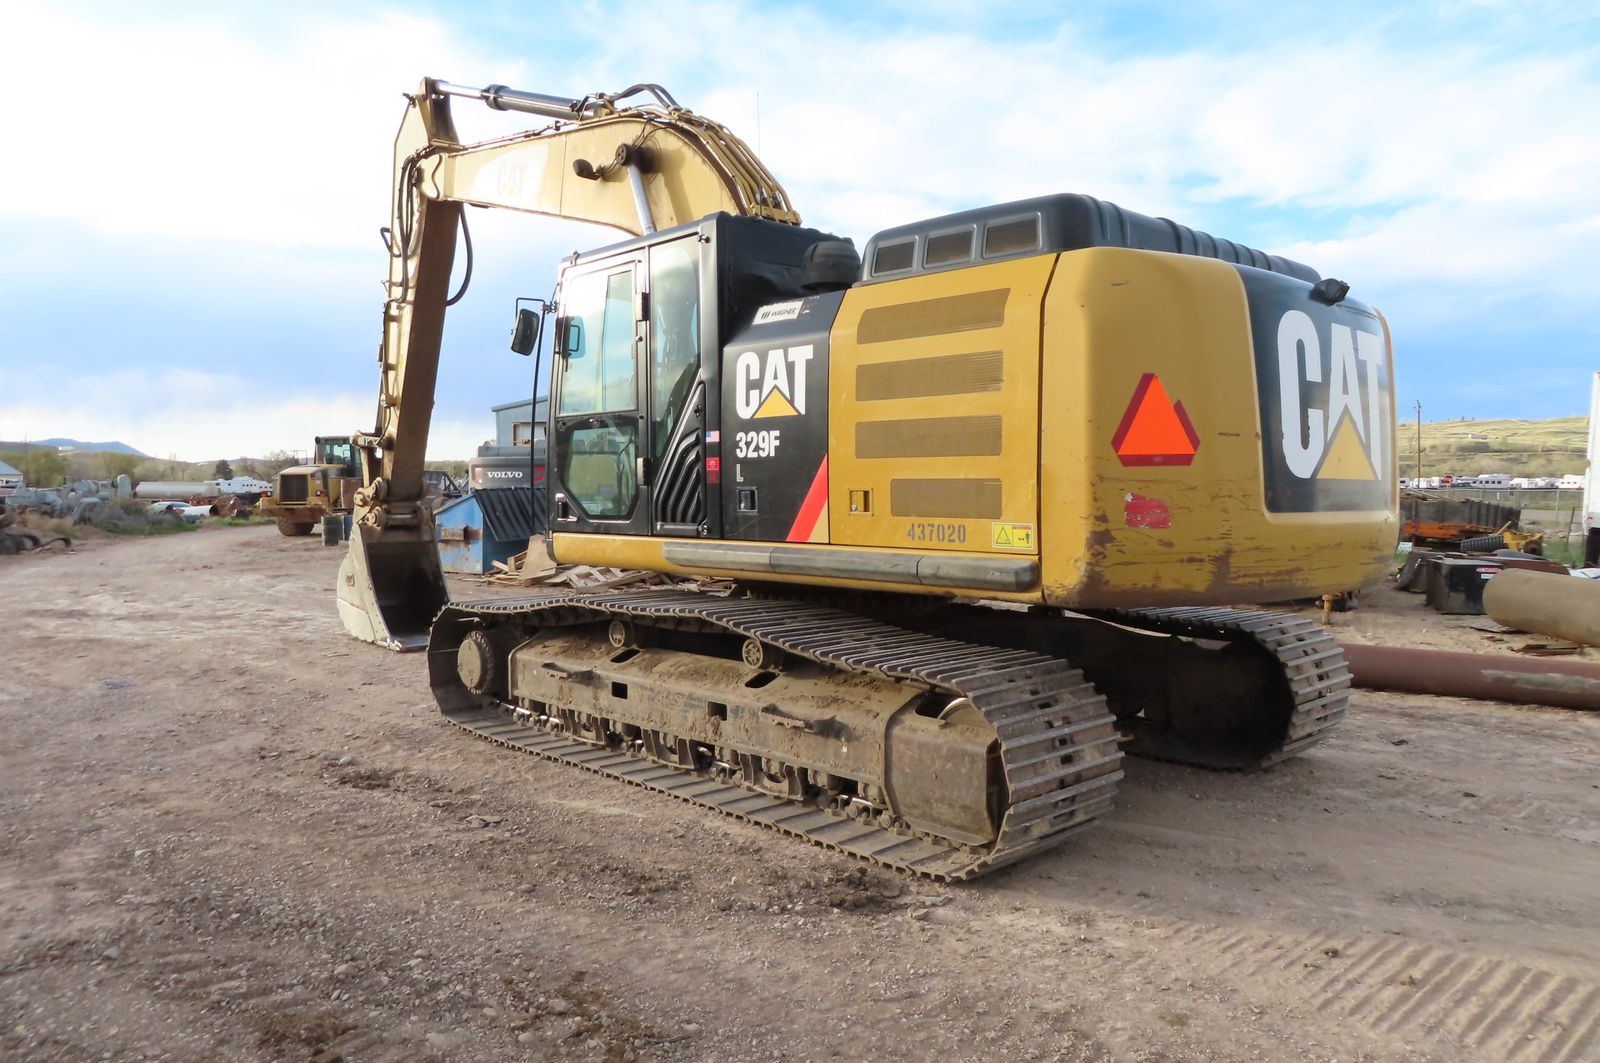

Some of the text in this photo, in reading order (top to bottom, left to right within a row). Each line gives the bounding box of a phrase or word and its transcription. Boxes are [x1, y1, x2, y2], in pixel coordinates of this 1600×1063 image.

[497, 160, 528, 197] CAT
[736, 344, 814, 420] CAT
[1277, 309, 1382, 481] CAT
[736, 430, 780, 458] 329F
[487, 471, 523, 479] VOLVO
[736, 463, 744, 483] L
[907, 523, 967, 543] 437020
